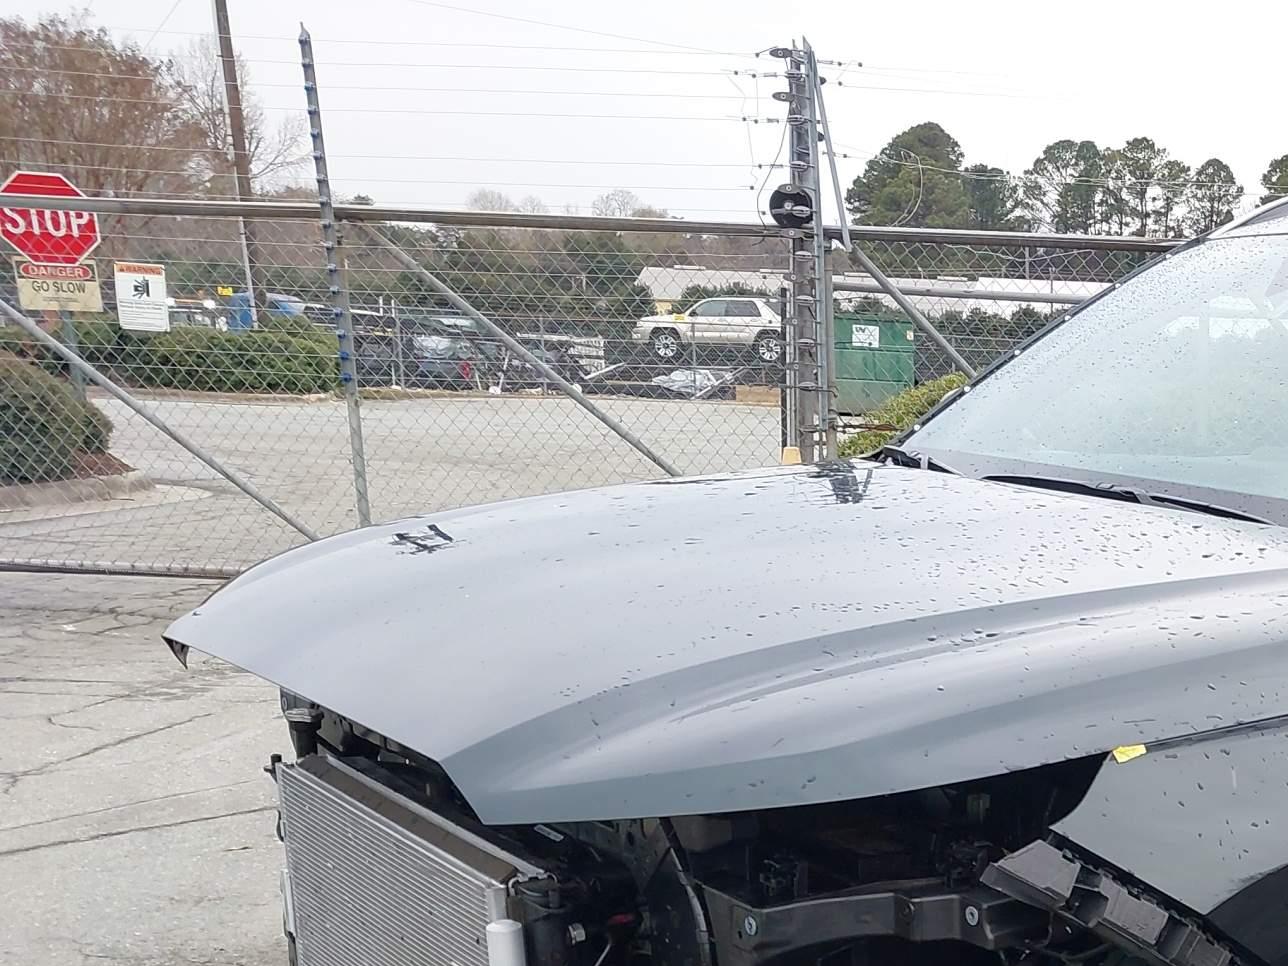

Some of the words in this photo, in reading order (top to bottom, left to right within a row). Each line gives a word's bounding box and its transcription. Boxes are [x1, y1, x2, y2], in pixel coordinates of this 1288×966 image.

[3, 207, 90, 237] STOP
[28, 265, 84, 278] DANGER
[32, 280, 50, 293] GO
[52, 282, 86, 294] SLOW
